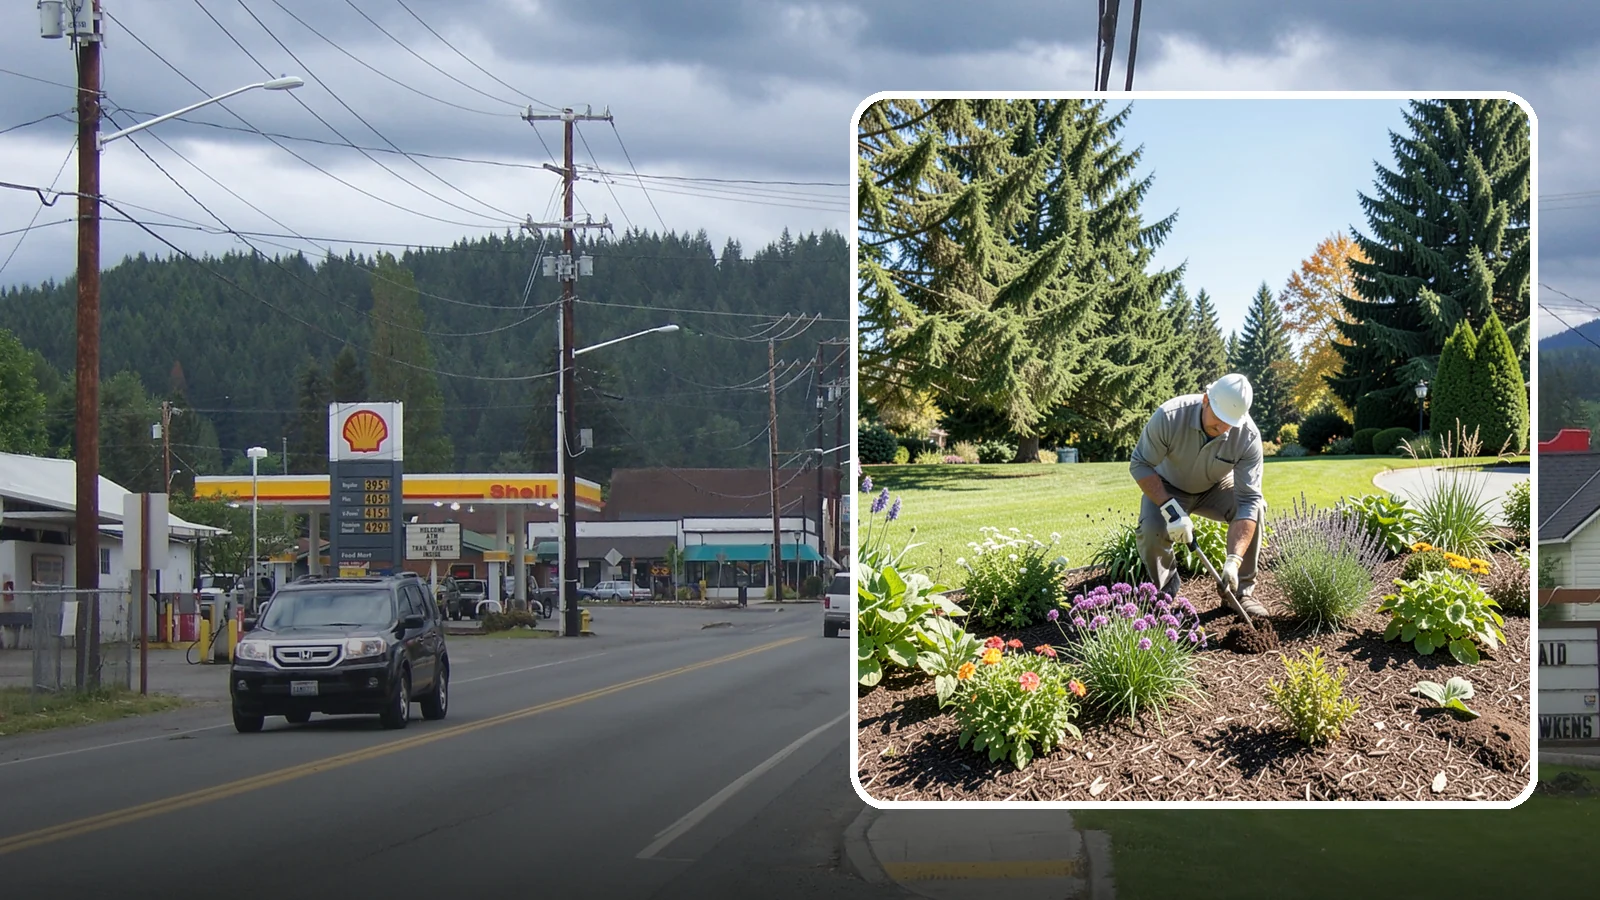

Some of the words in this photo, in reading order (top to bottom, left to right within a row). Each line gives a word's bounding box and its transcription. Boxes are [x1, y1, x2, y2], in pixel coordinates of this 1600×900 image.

[366, 480, 383, 490] 395
[490, 484, 547, 499] Shell
[366, 494, 383, 504] 405
[366, 508, 383, 518] 415
[366, 522, 383, 532] 429
